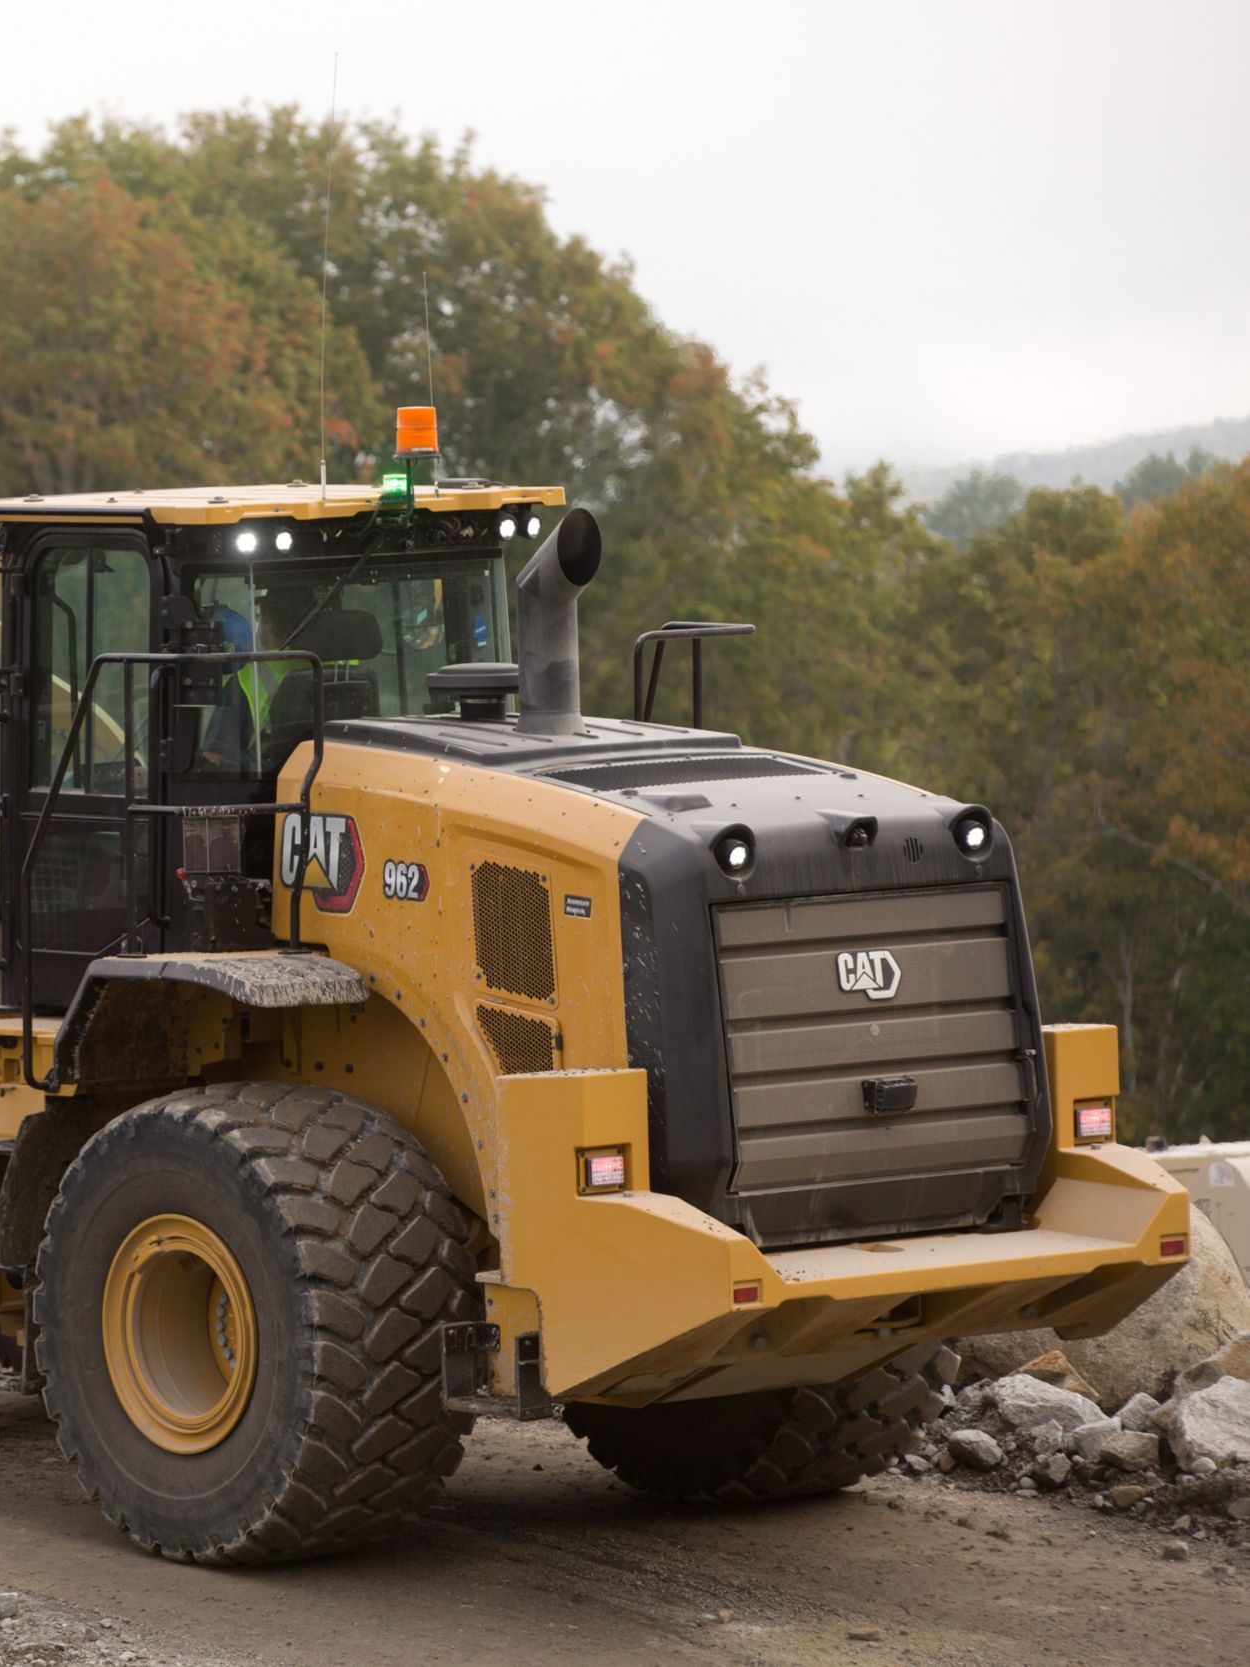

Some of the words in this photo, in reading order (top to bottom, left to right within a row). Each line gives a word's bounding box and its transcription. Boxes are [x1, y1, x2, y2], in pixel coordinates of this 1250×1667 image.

[282, 813, 346, 892] CAT
[384, 861, 420, 899] 962
[837, 950, 886, 991] CAT
